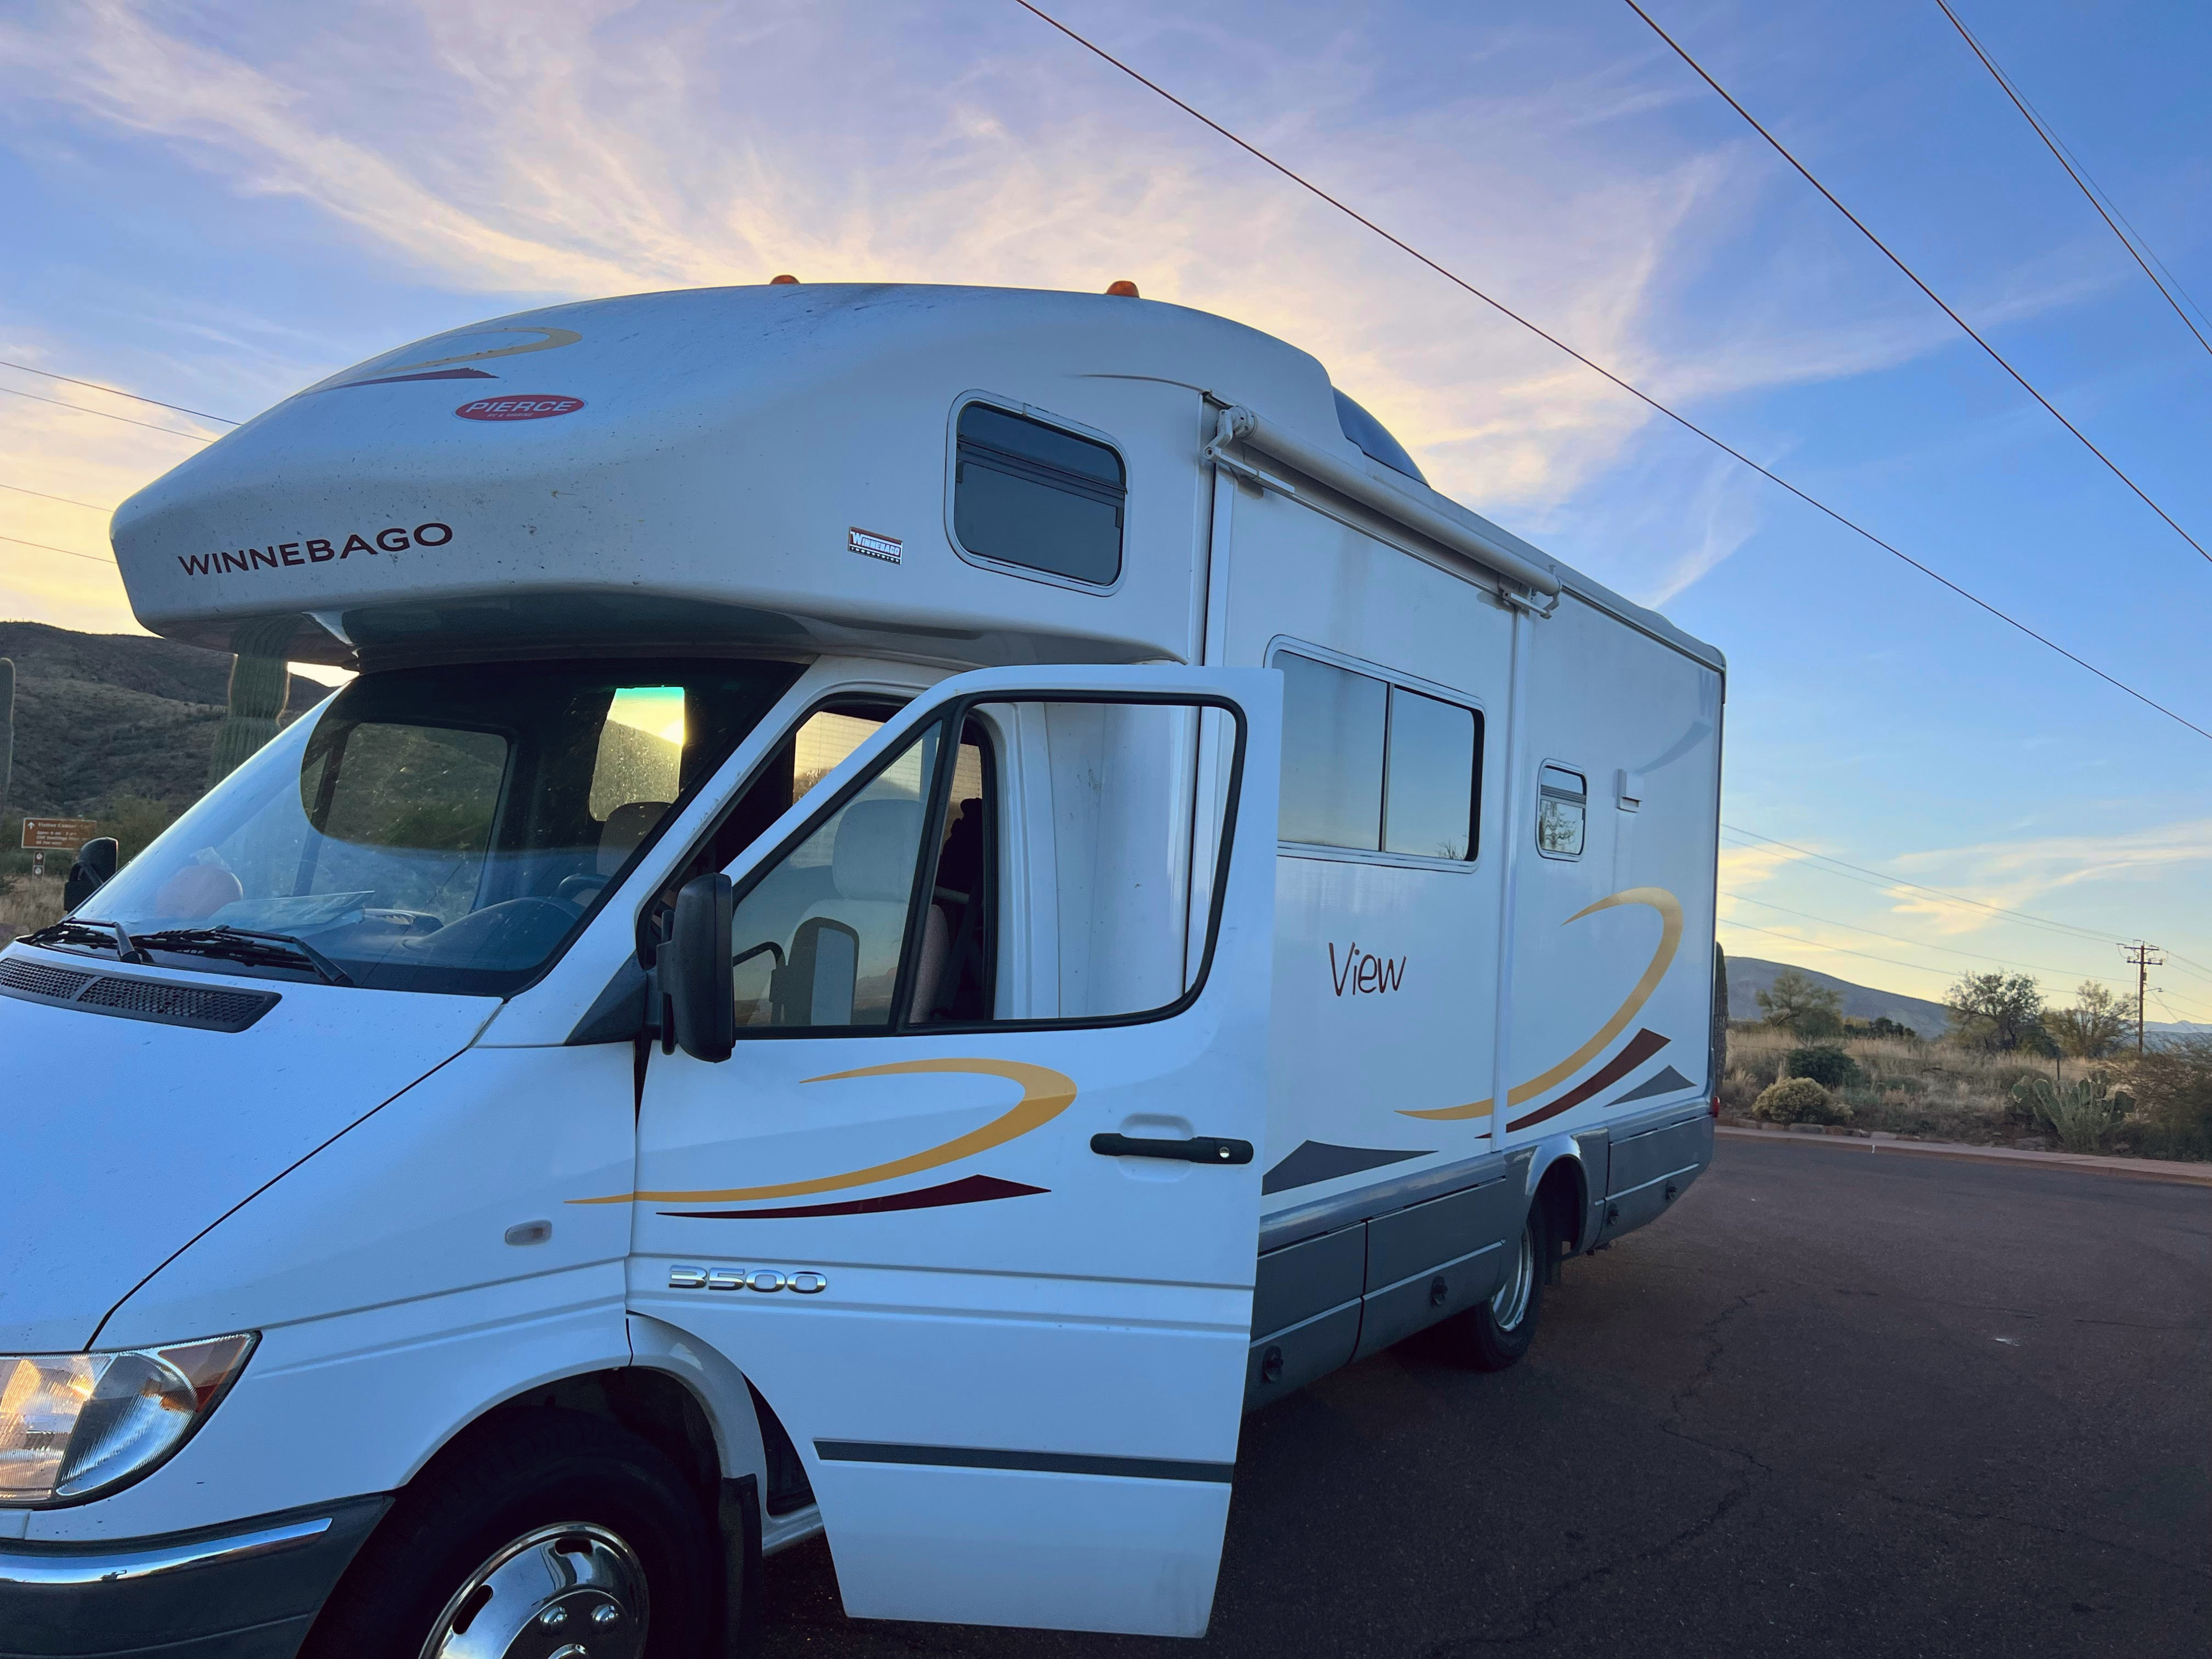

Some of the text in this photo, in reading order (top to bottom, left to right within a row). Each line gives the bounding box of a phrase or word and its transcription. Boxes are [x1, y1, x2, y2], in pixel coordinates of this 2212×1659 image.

[465, 400, 577, 413] PIERCE
[177, 523, 453, 576] WINNEBAGO
[850, 531, 900, 556] WINNEBAGO
[1329, 941, 1407, 997] View
[669, 1265, 827, 1294] 3500
